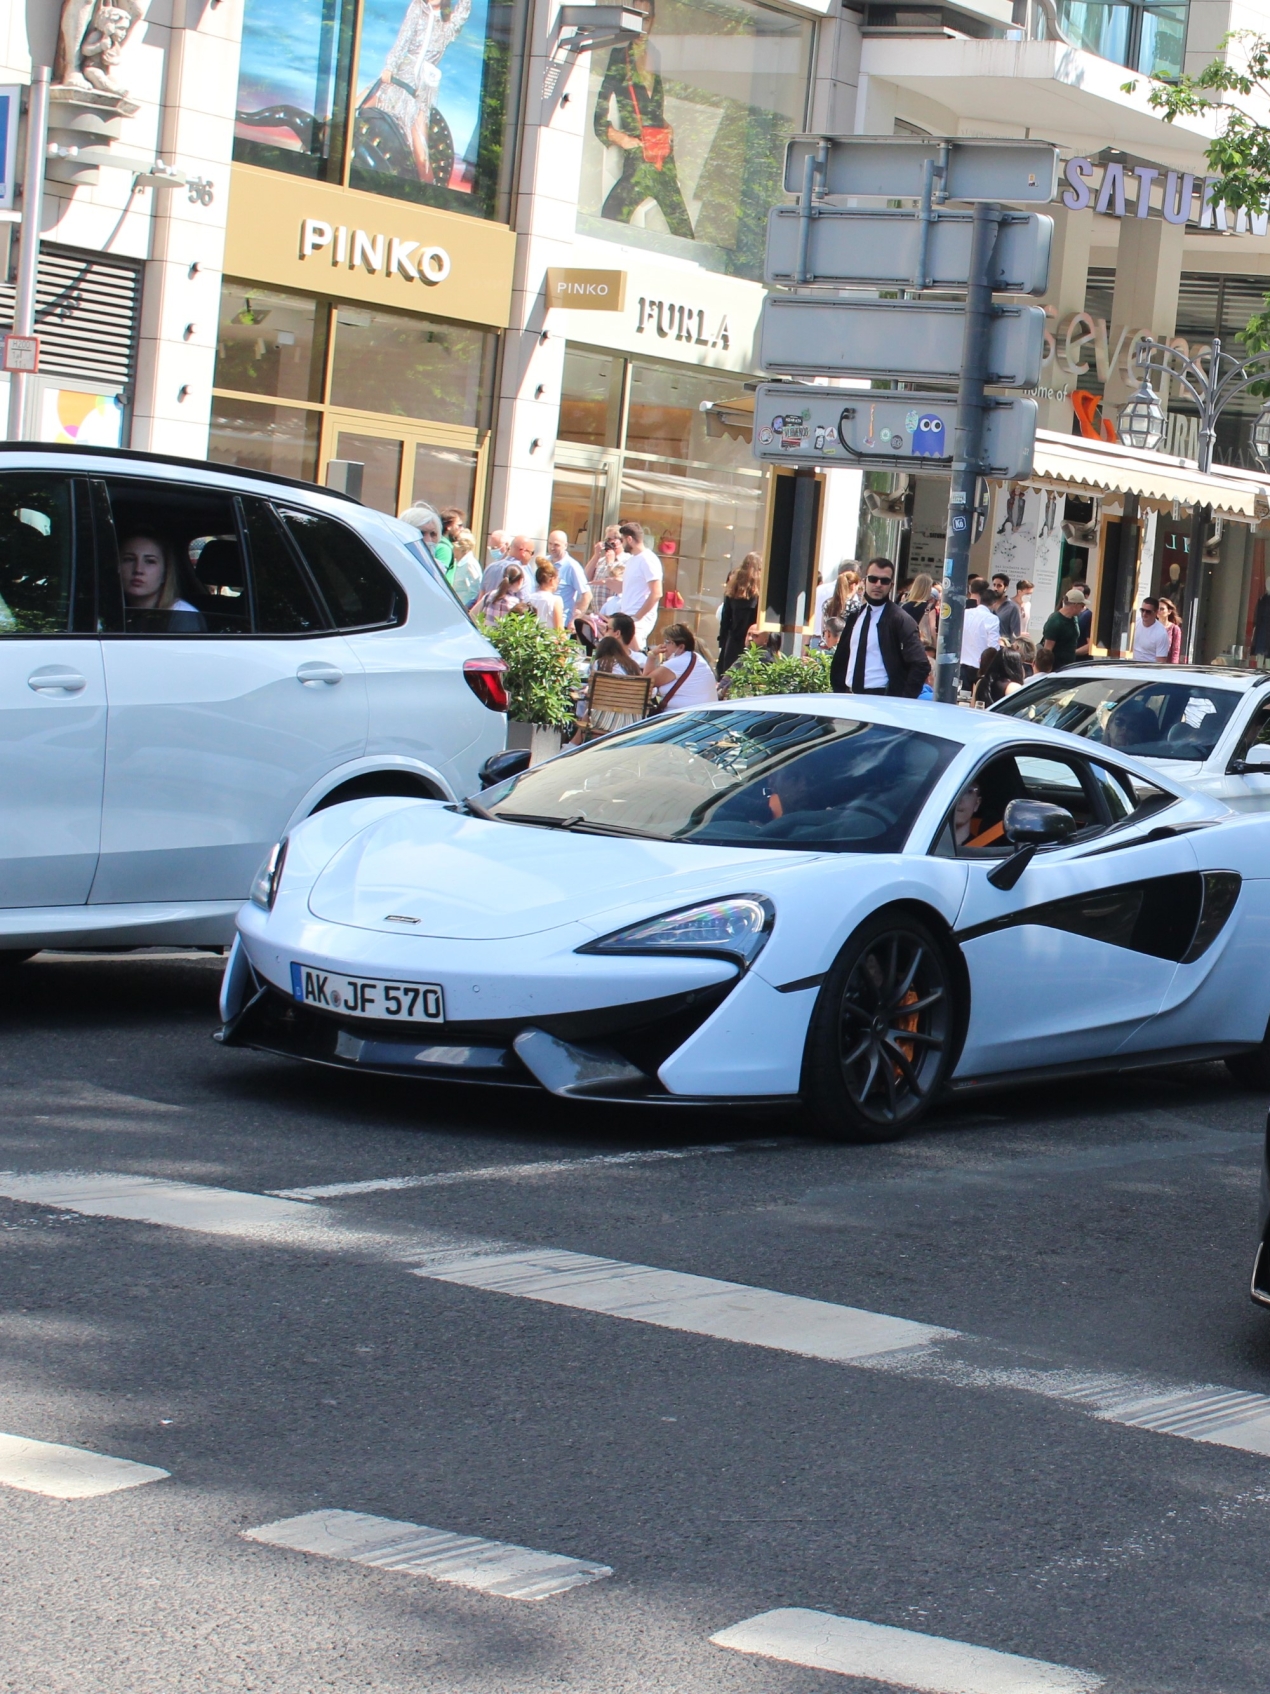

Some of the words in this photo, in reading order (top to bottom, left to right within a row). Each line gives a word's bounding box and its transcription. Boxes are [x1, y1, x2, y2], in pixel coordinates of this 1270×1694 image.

[300, 218, 451, 285] PINKO
[557, 282, 609, 296] PINKO
[635, 297, 730, 351] FURLA
[1056, 383, 1069, 402] of
[305, 971, 330, 1006] AK
[344, 981, 377, 1013] JF
[384, 985, 441, 1019] 570
